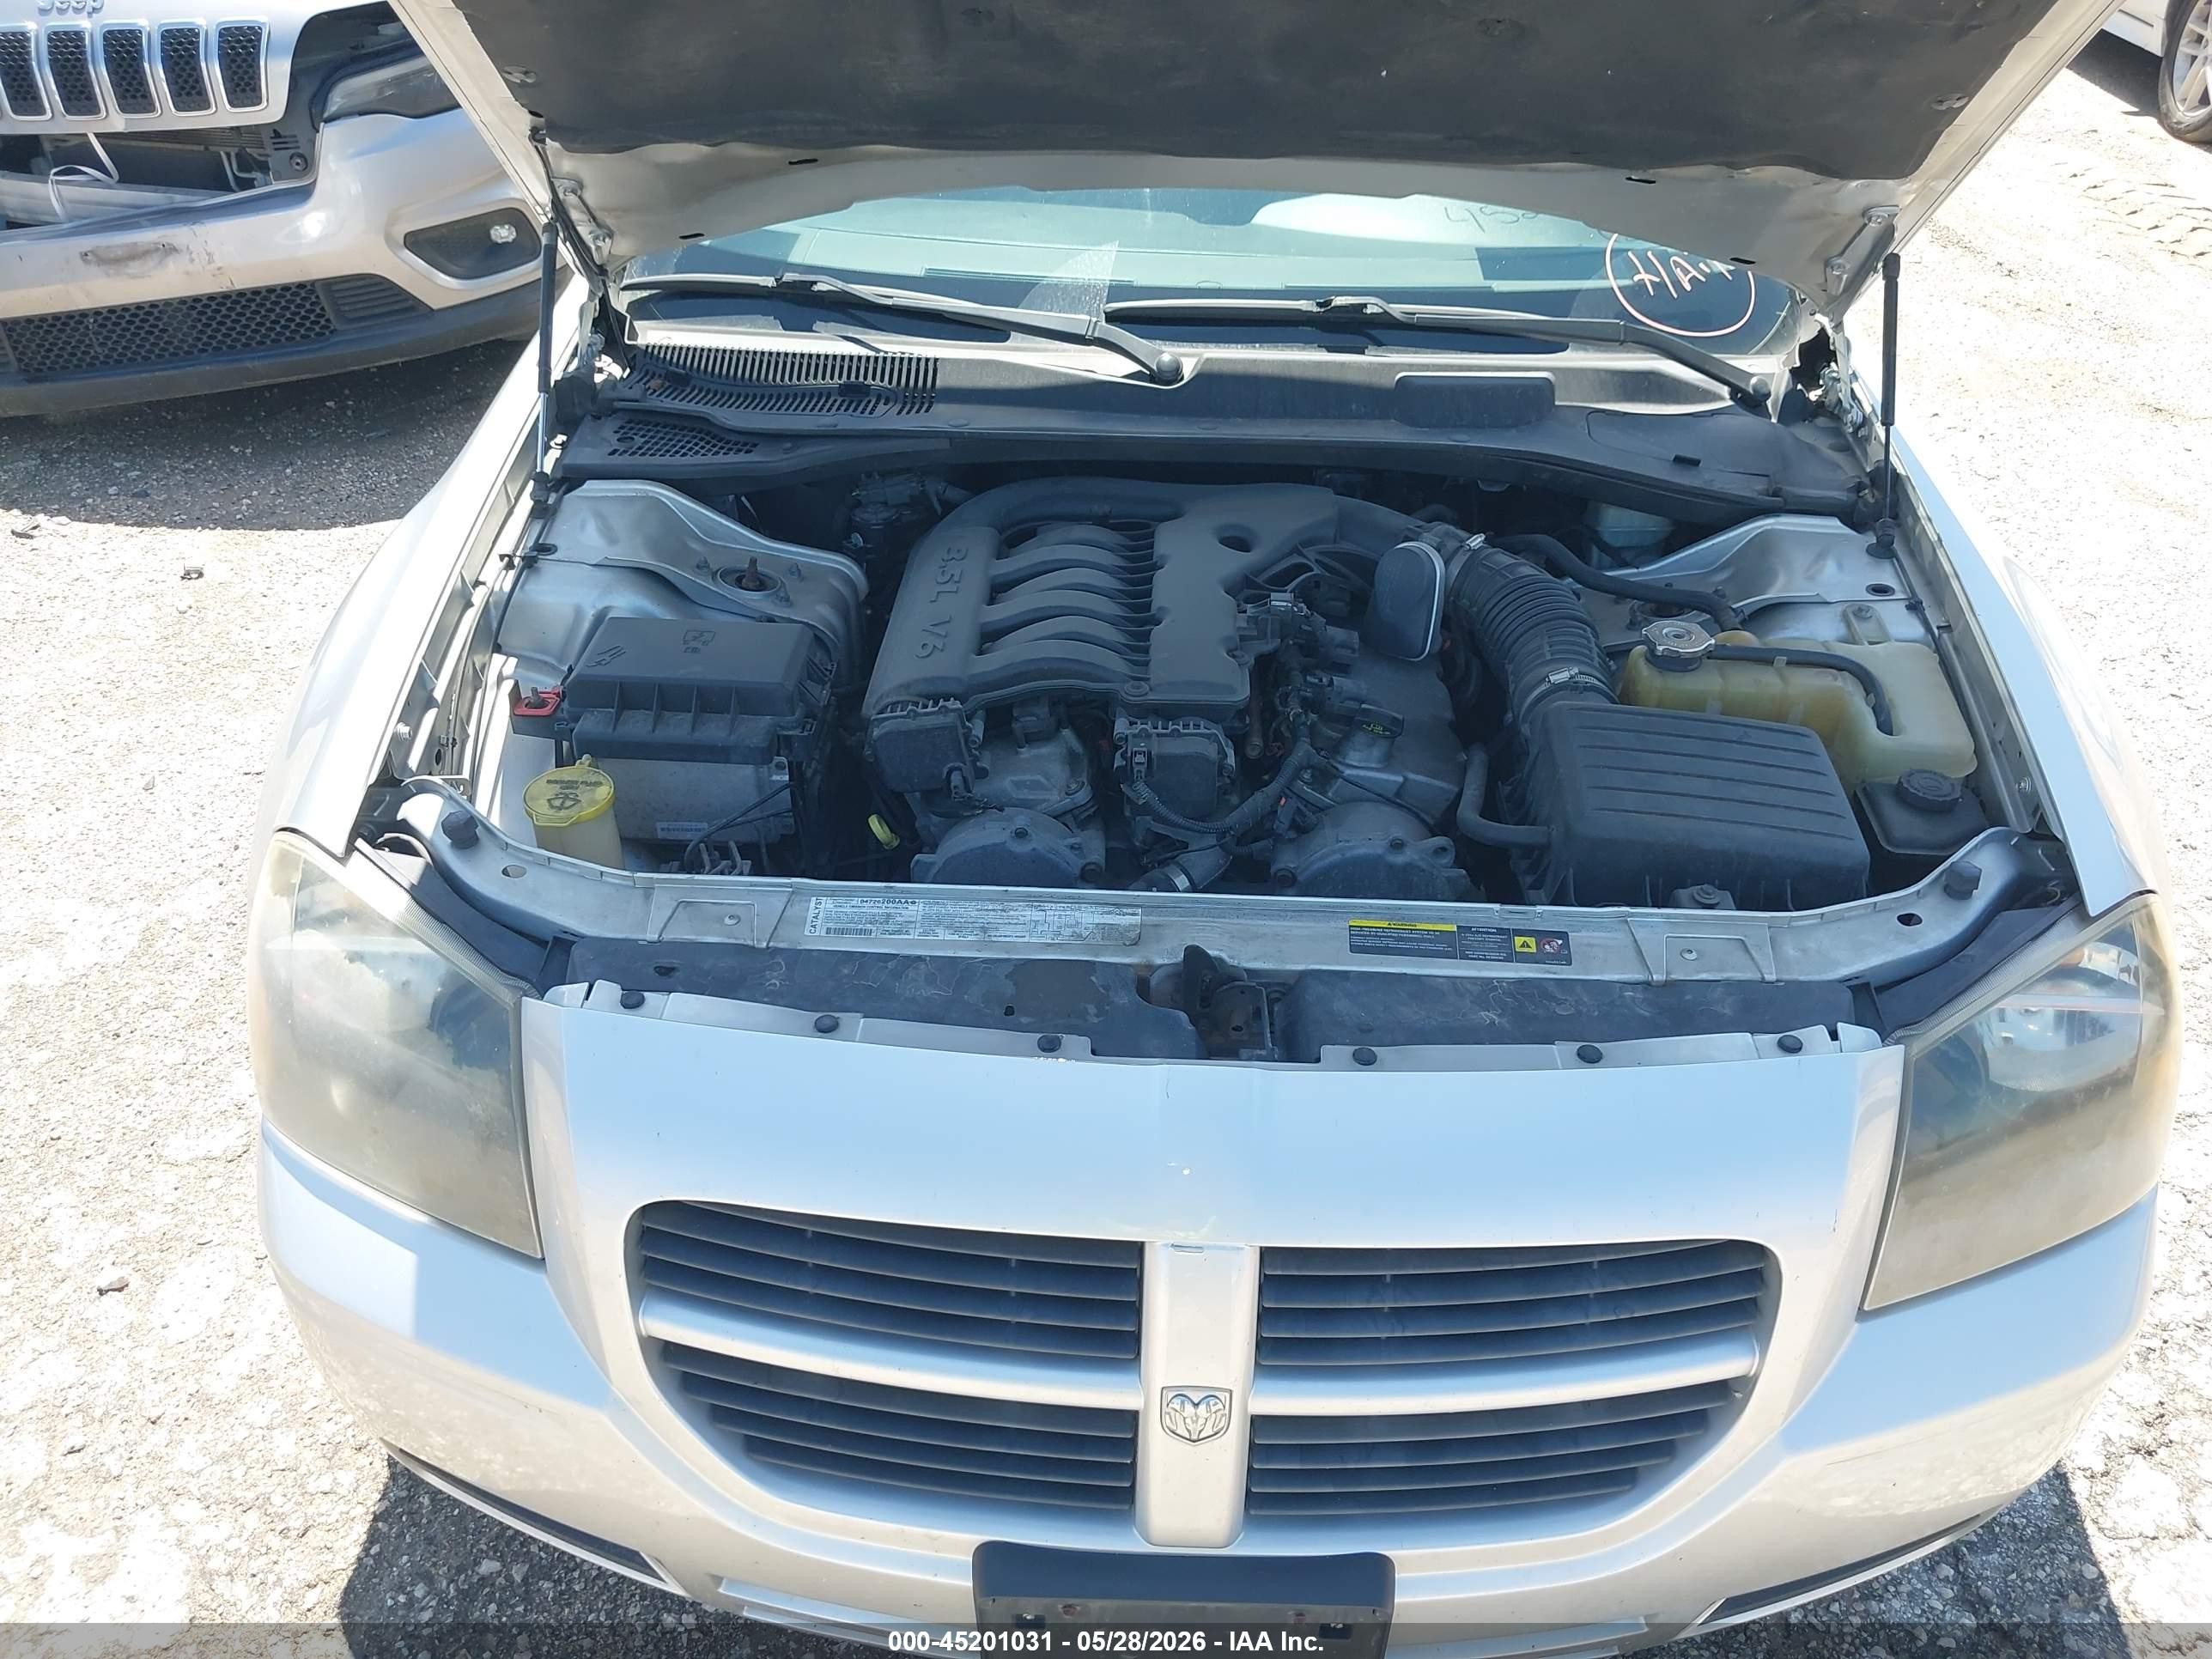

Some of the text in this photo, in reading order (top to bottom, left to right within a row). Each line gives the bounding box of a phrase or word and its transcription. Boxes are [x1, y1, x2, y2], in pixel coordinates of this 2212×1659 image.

[915, 546, 969, 659] 3.5L V6
[809, 897, 824, 934] CATALYST
